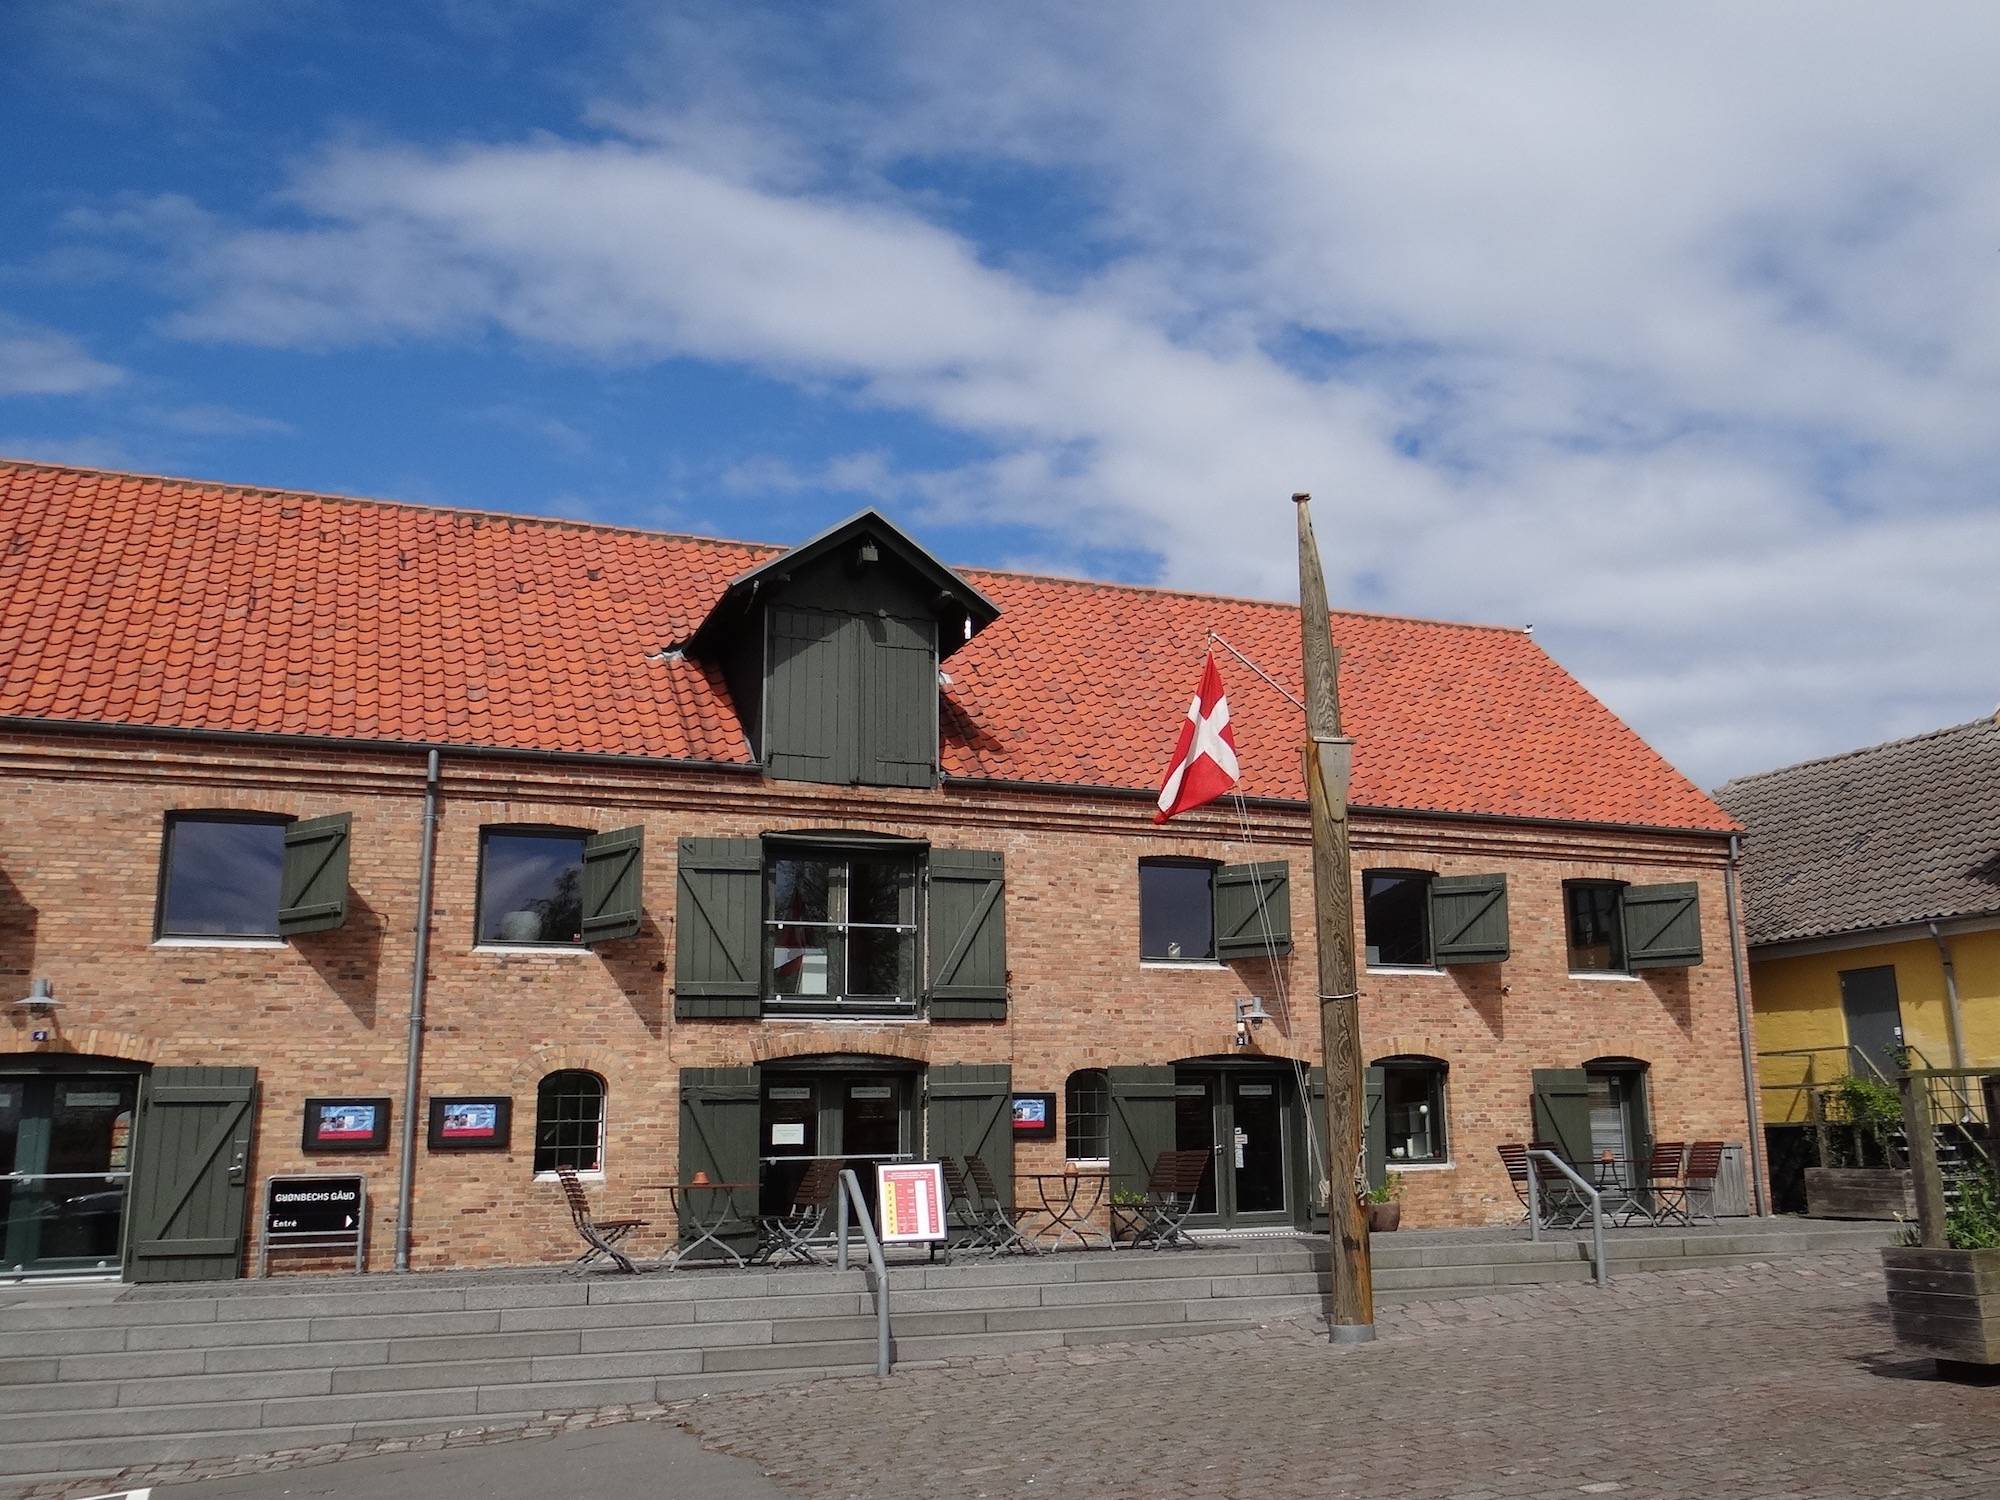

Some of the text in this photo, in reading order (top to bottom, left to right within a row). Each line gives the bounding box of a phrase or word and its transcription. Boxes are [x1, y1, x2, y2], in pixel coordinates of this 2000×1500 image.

[35, 1032, 44, 1040] 4
[275, 1190, 356, 1202] GRØNBECHS GÅRD
[273, 1219, 298, 1228] Entré
